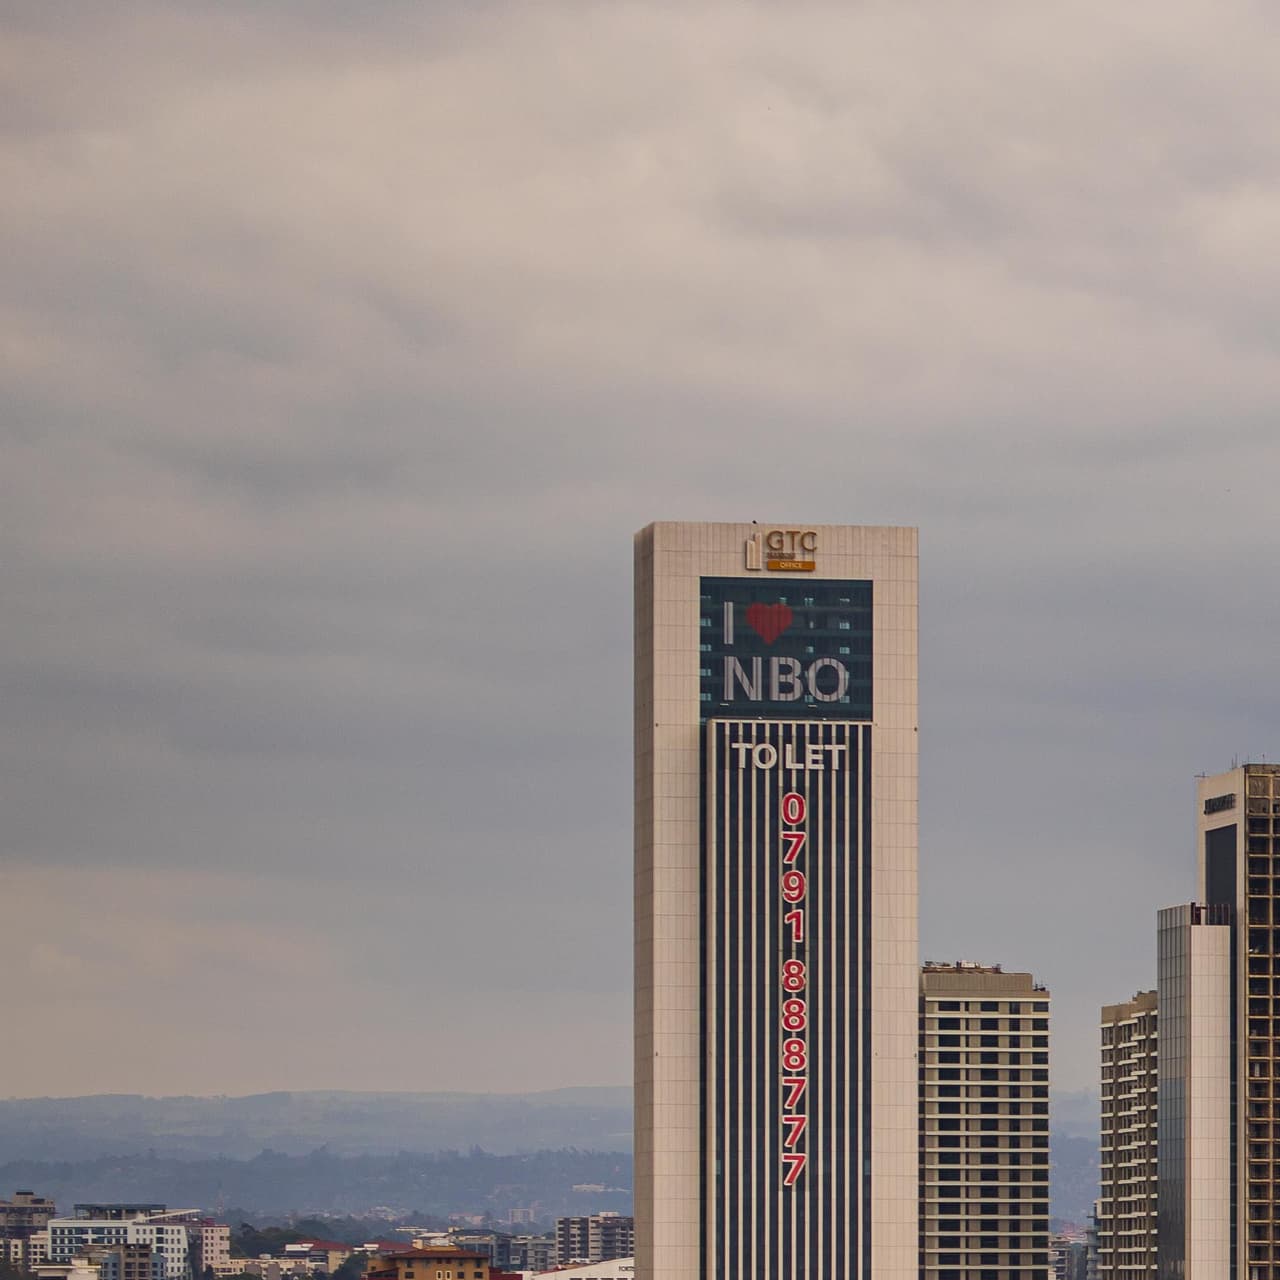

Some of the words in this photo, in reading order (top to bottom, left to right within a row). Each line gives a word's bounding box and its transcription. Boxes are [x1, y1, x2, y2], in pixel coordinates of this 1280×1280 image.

[766, 530, 818, 552] GTC
[723, 655, 849, 702] NBO
[731, 743, 777, 769] TO
[785, 744, 847, 770] LET
